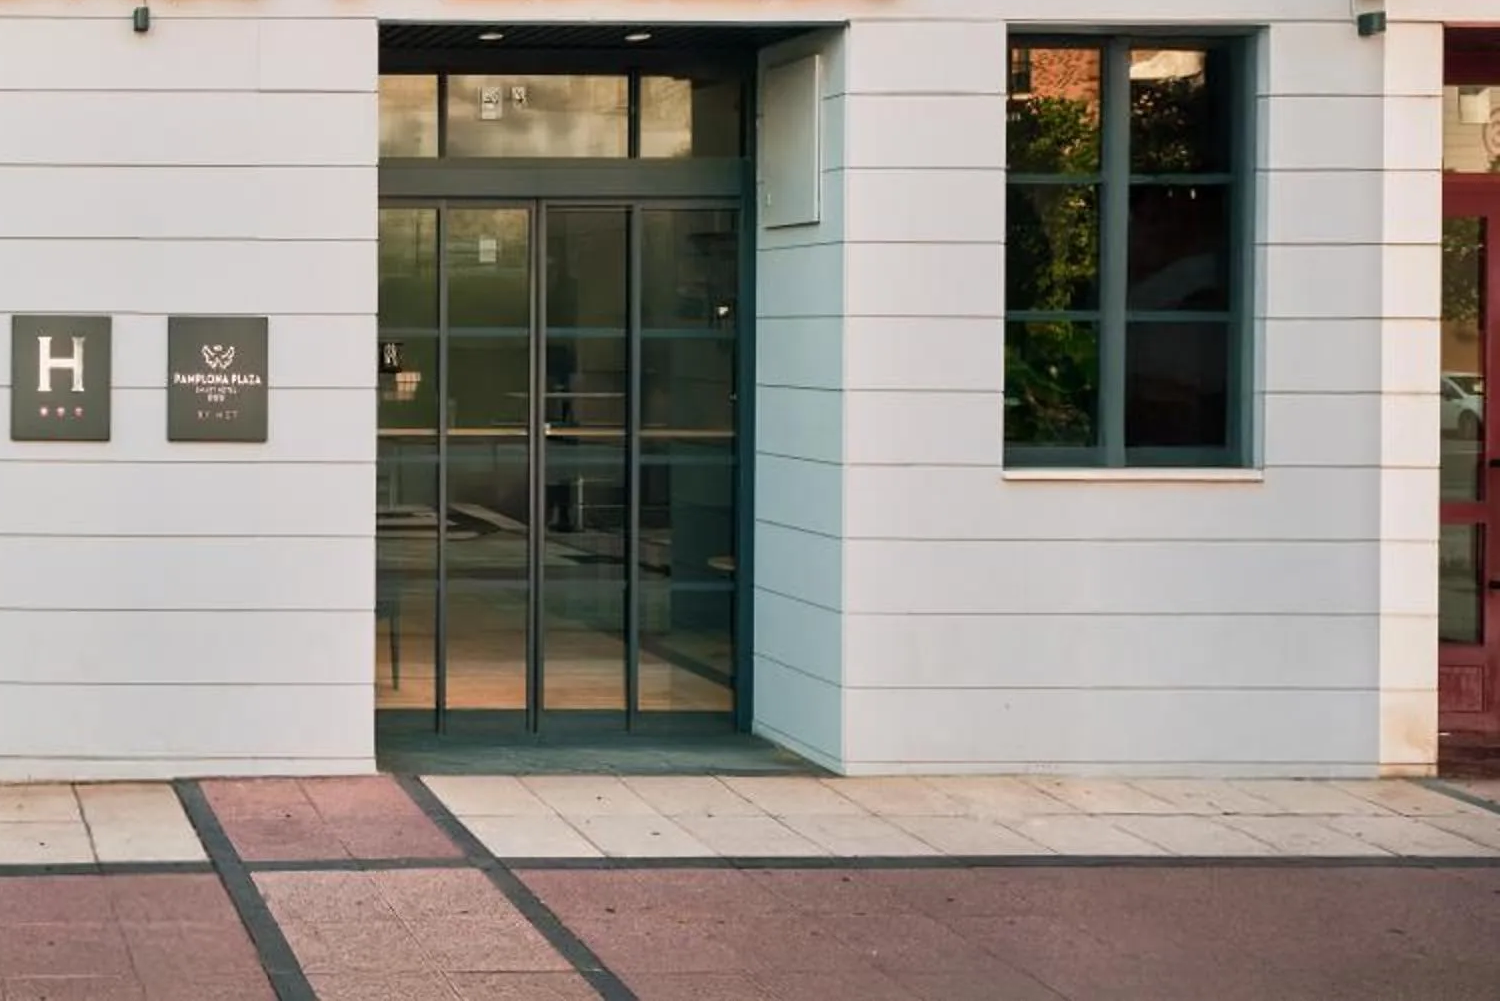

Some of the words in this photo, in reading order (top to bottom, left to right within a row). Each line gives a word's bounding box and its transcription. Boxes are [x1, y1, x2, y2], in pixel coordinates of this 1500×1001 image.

[37, 336, 85, 392] H
[174, 372, 229, 385] PAMPLONA
[231, 373, 262, 385] PLAZA
